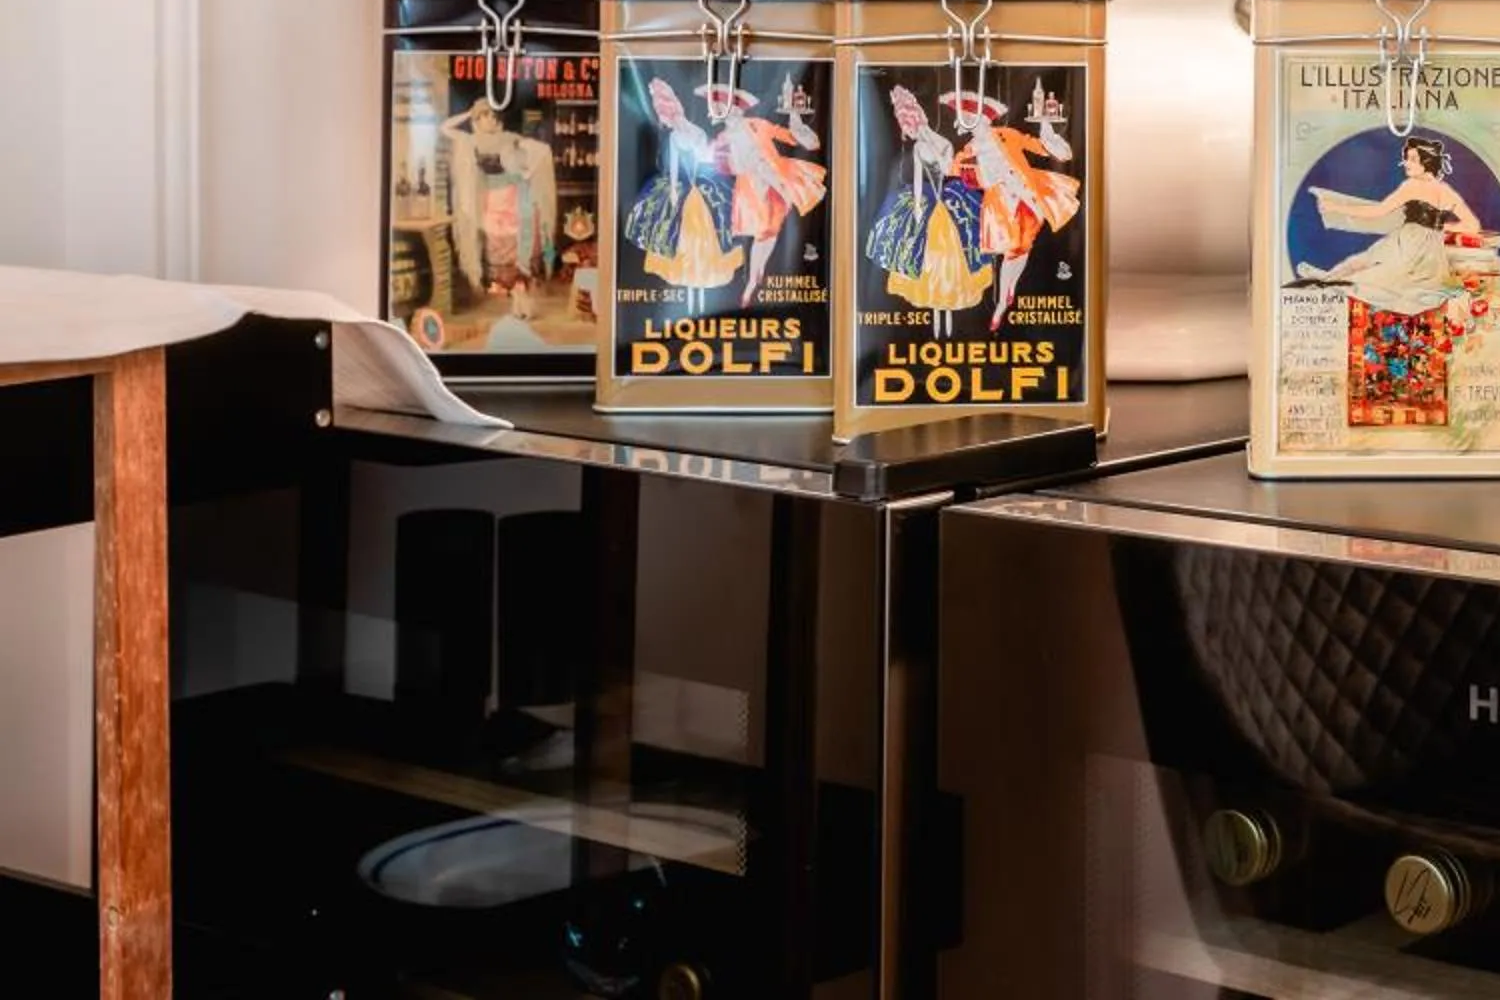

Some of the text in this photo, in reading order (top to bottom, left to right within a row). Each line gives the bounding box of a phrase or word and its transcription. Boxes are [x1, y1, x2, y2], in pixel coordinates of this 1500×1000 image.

[563, 61, 576, 81] &
[1343, 89, 1459, 110] ITAINA
[767, 275, 819, 289] KUMMEL
[1017, 295, 1074, 309] KUMMEL
[645, 318, 801, 340] LIQUEURS
[631, 341, 814, 375] DOLFI
[888, 341, 1056, 366] LIQUEURS
[874, 366, 1069, 403] DOLFI
